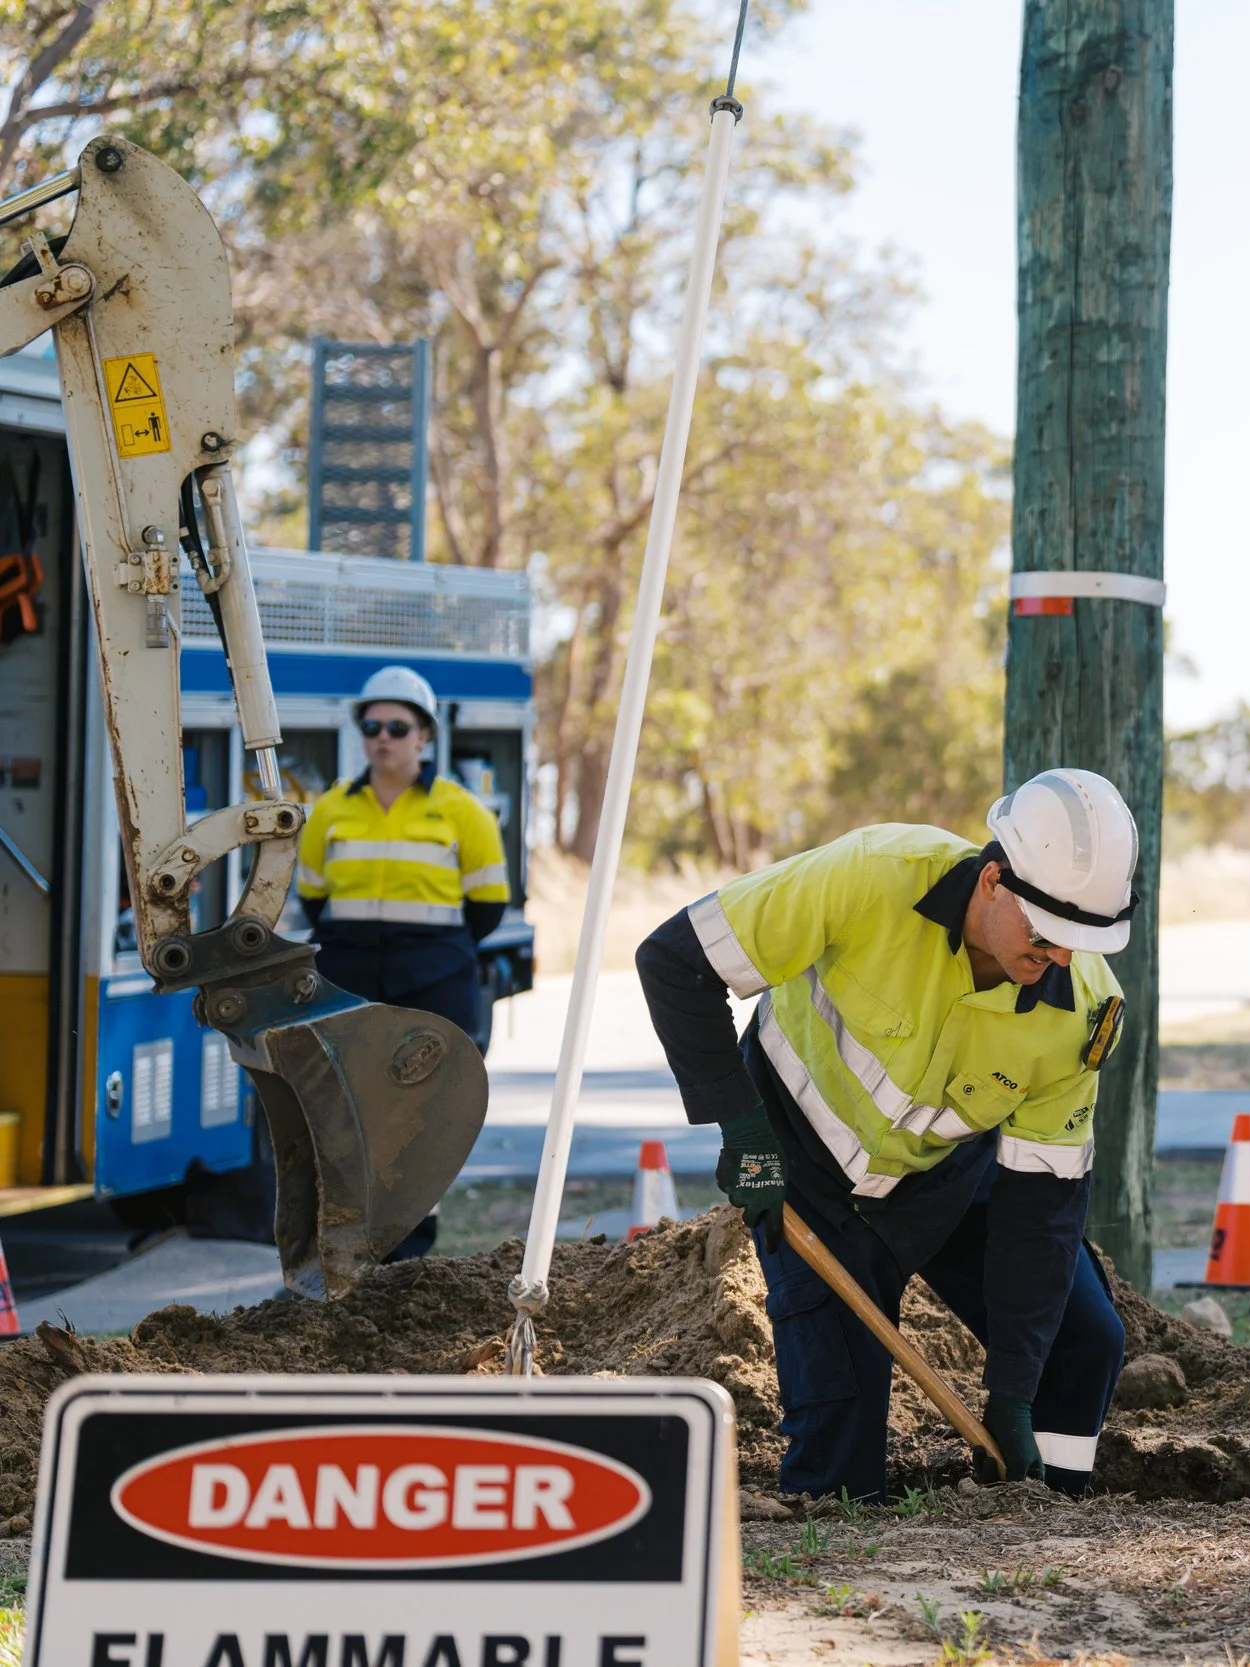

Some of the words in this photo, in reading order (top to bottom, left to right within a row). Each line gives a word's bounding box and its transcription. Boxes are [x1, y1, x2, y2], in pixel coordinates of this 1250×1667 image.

[991, 1071, 1018, 1090] ATCO
[739, 1180, 785, 1189] MaxiFlex
[187, 1463, 576, 1531] DANGER
